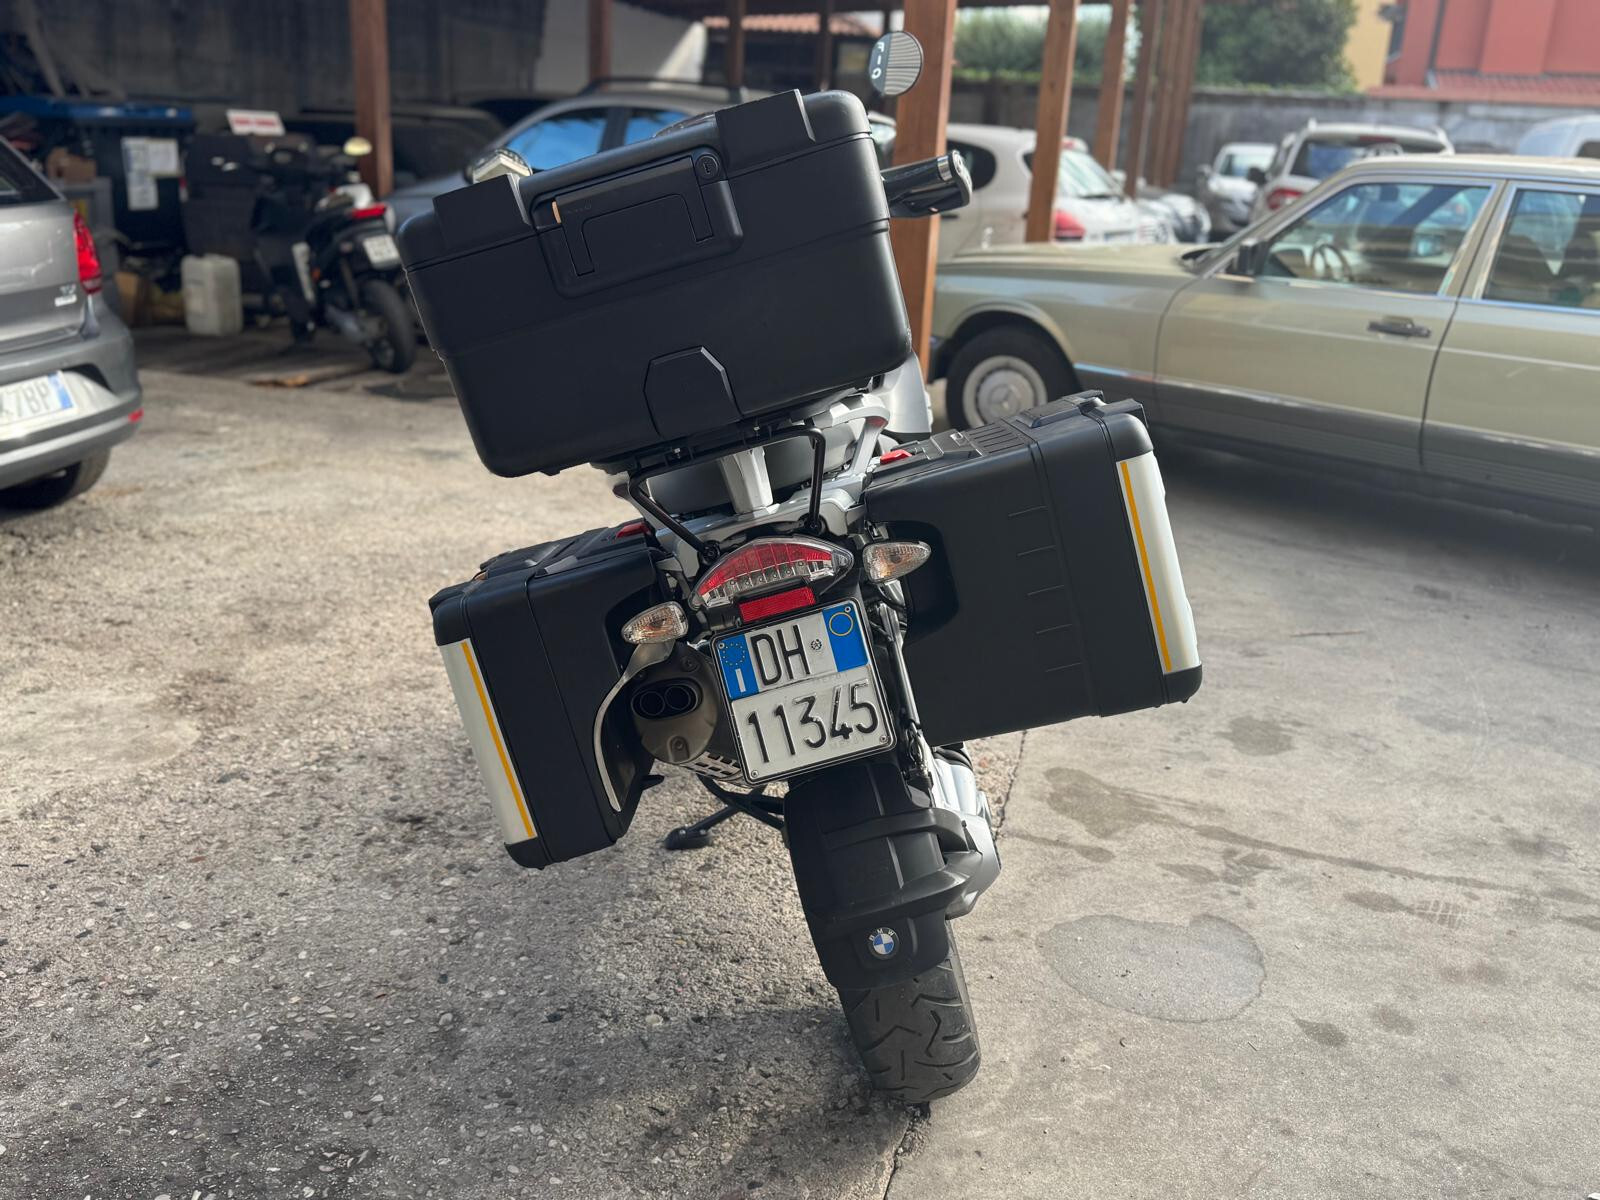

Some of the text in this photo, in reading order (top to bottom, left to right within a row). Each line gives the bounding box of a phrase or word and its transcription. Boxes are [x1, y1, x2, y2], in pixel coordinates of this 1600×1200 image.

[750, 624, 811, 686] DH
[748, 679, 879, 763] 11345
[868, 928, 896, 942] BMW
